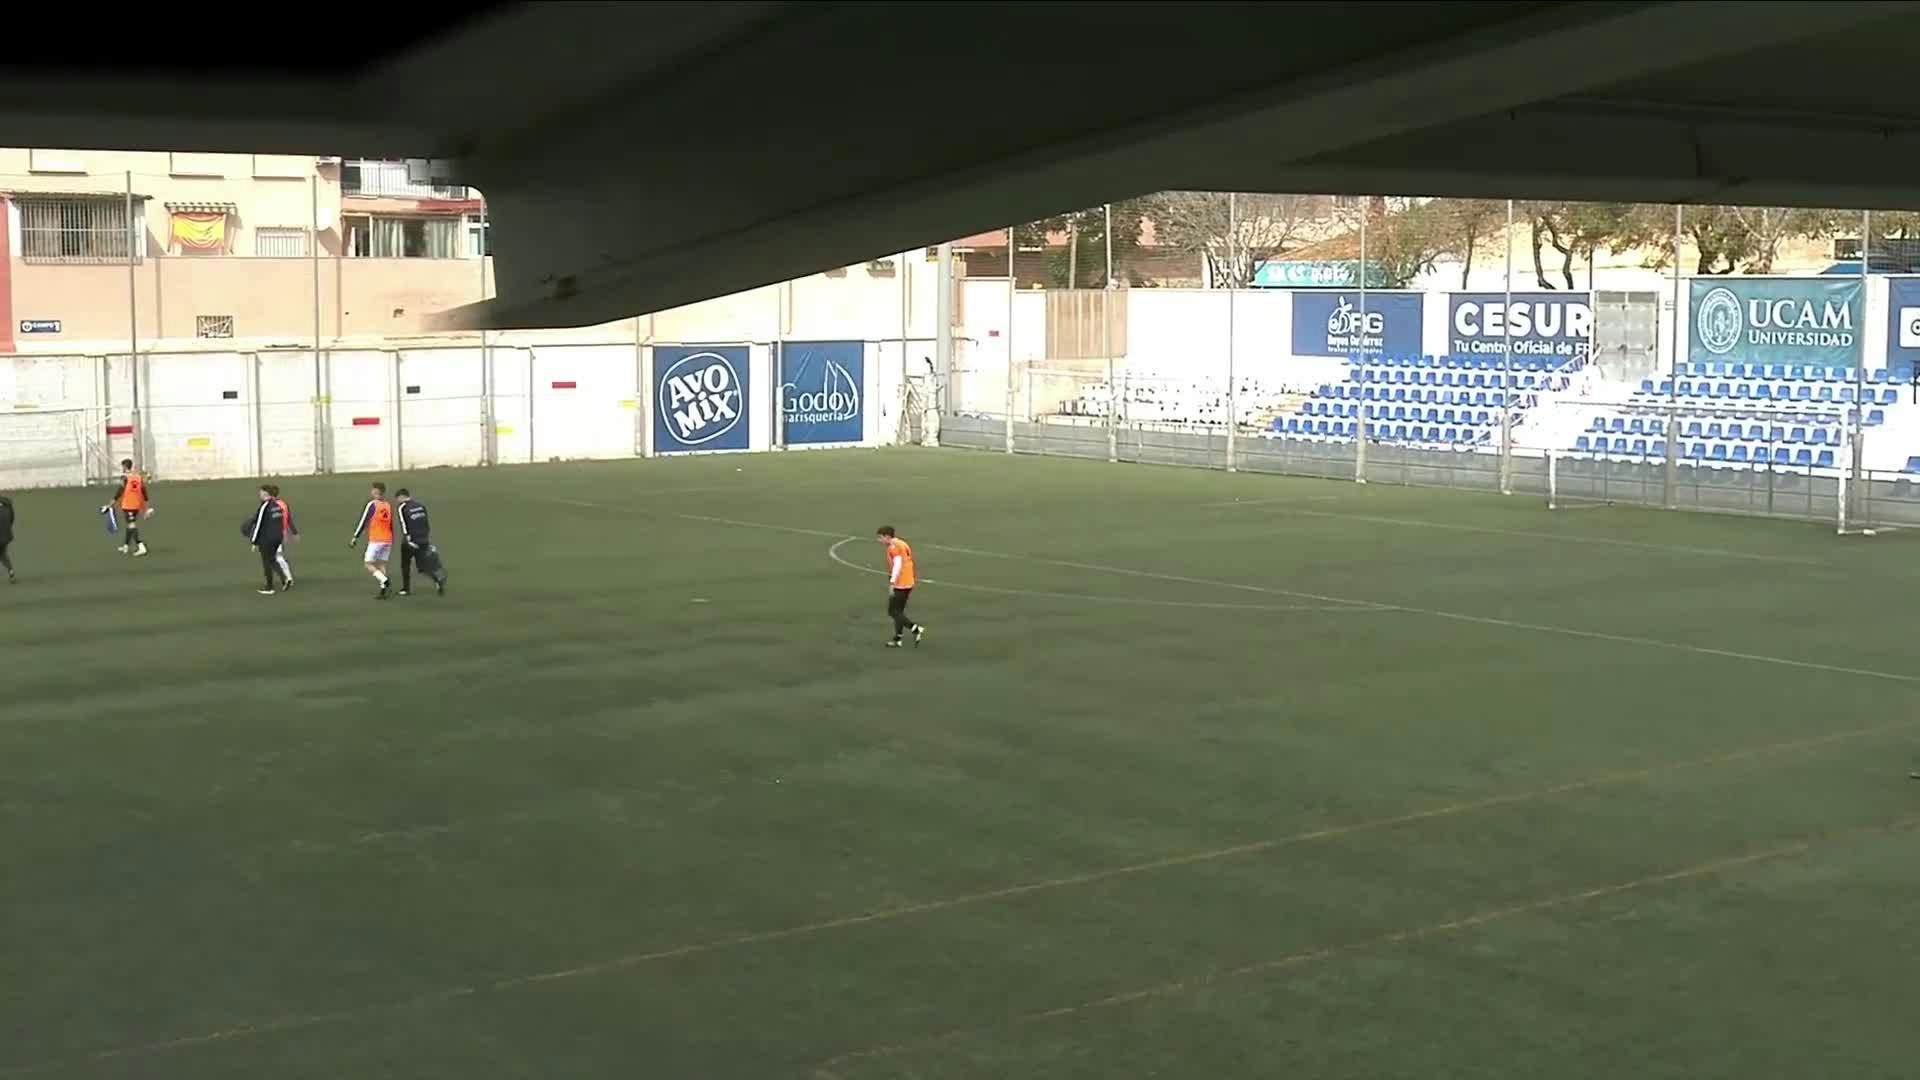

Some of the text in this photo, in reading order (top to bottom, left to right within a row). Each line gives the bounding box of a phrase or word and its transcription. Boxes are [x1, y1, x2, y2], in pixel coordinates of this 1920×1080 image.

[1455, 302, 1590, 337] CESUR
[1749, 299, 1852, 329] UCAM
[1454, 340, 1469, 352] Tu
[1471, 340, 1511, 353] Centro
[1513, 340, 1554, 354] Oficial
[1556, 342, 1573, 355] de
[1748, 329, 1853, 347] UNIVERSIDAD
